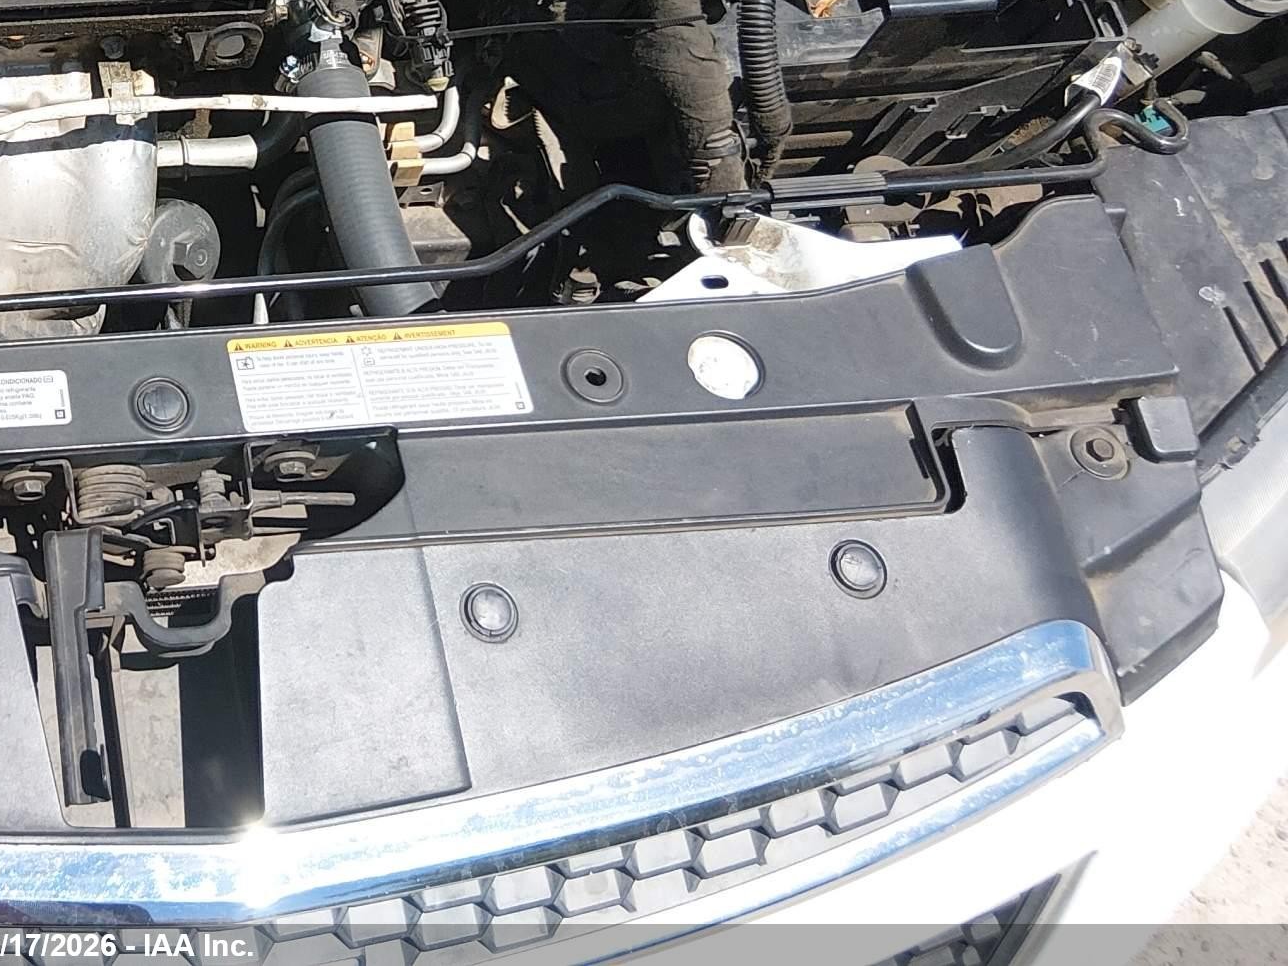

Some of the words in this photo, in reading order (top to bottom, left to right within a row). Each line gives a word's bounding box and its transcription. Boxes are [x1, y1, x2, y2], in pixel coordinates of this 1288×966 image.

[403, 329, 456, 339] AVERTISSEMENT
[244, 341, 277, 350] WARNING
[294, 337, 339, 347] ADVERTENCIA
